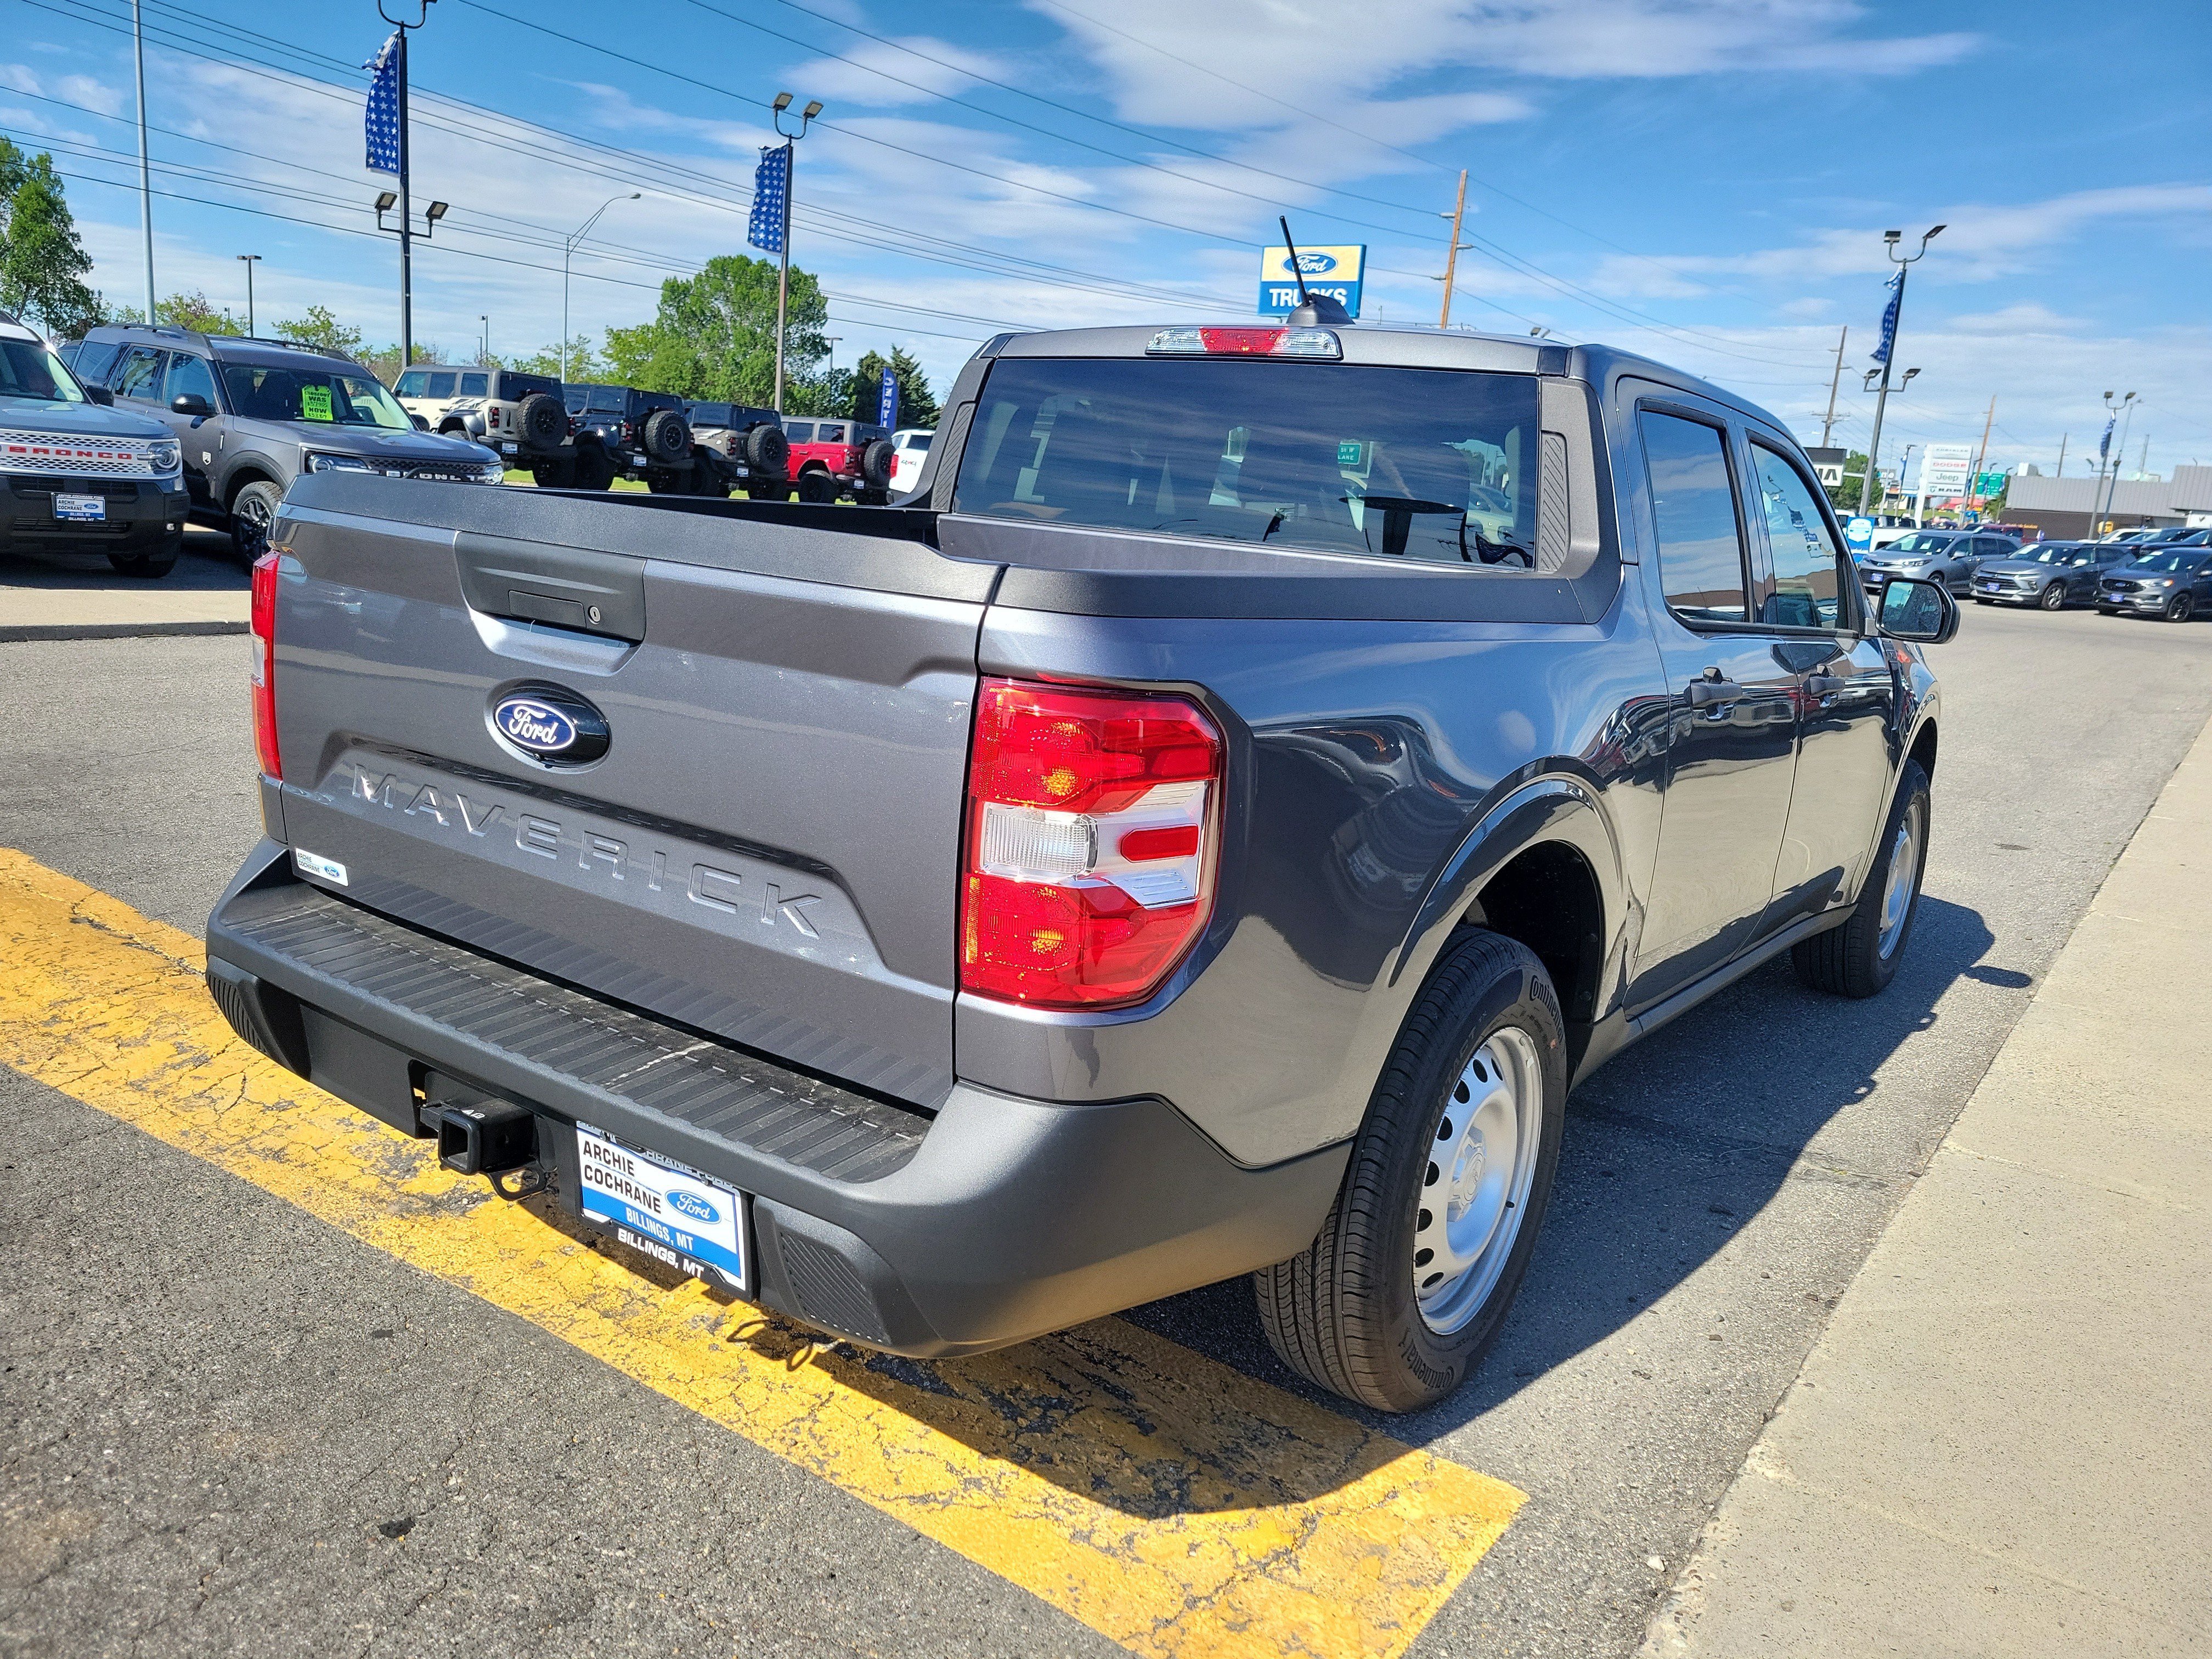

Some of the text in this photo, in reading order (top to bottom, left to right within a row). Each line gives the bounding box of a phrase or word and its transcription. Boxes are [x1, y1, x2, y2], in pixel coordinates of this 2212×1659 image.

[1292, 255, 1329, 272] Ford
[1269, 288, 1348, 307] TRUS
[9, 446, 132, 460] BRONCO
[1815, 468, 1838, 481] IA
[1936, 473, 1959, 482] Jeep
[508, 706, 559, 744] Ford
[297, 852, 312, 862] ARCHIE
[351, 763, 822, 939] MAVERICK
[298, 860, 320, 873] COCHRANE
[583, 1140, 635, 1177] ARCHIE
[584, 1164, 662, 1215] COCHRANE
[676, 1193, 711, 1220] Ford
[625, 1206, 694, 1251] BILLINGS, MT
[617, 1228, 704, 1279] BILLINGS, MT
